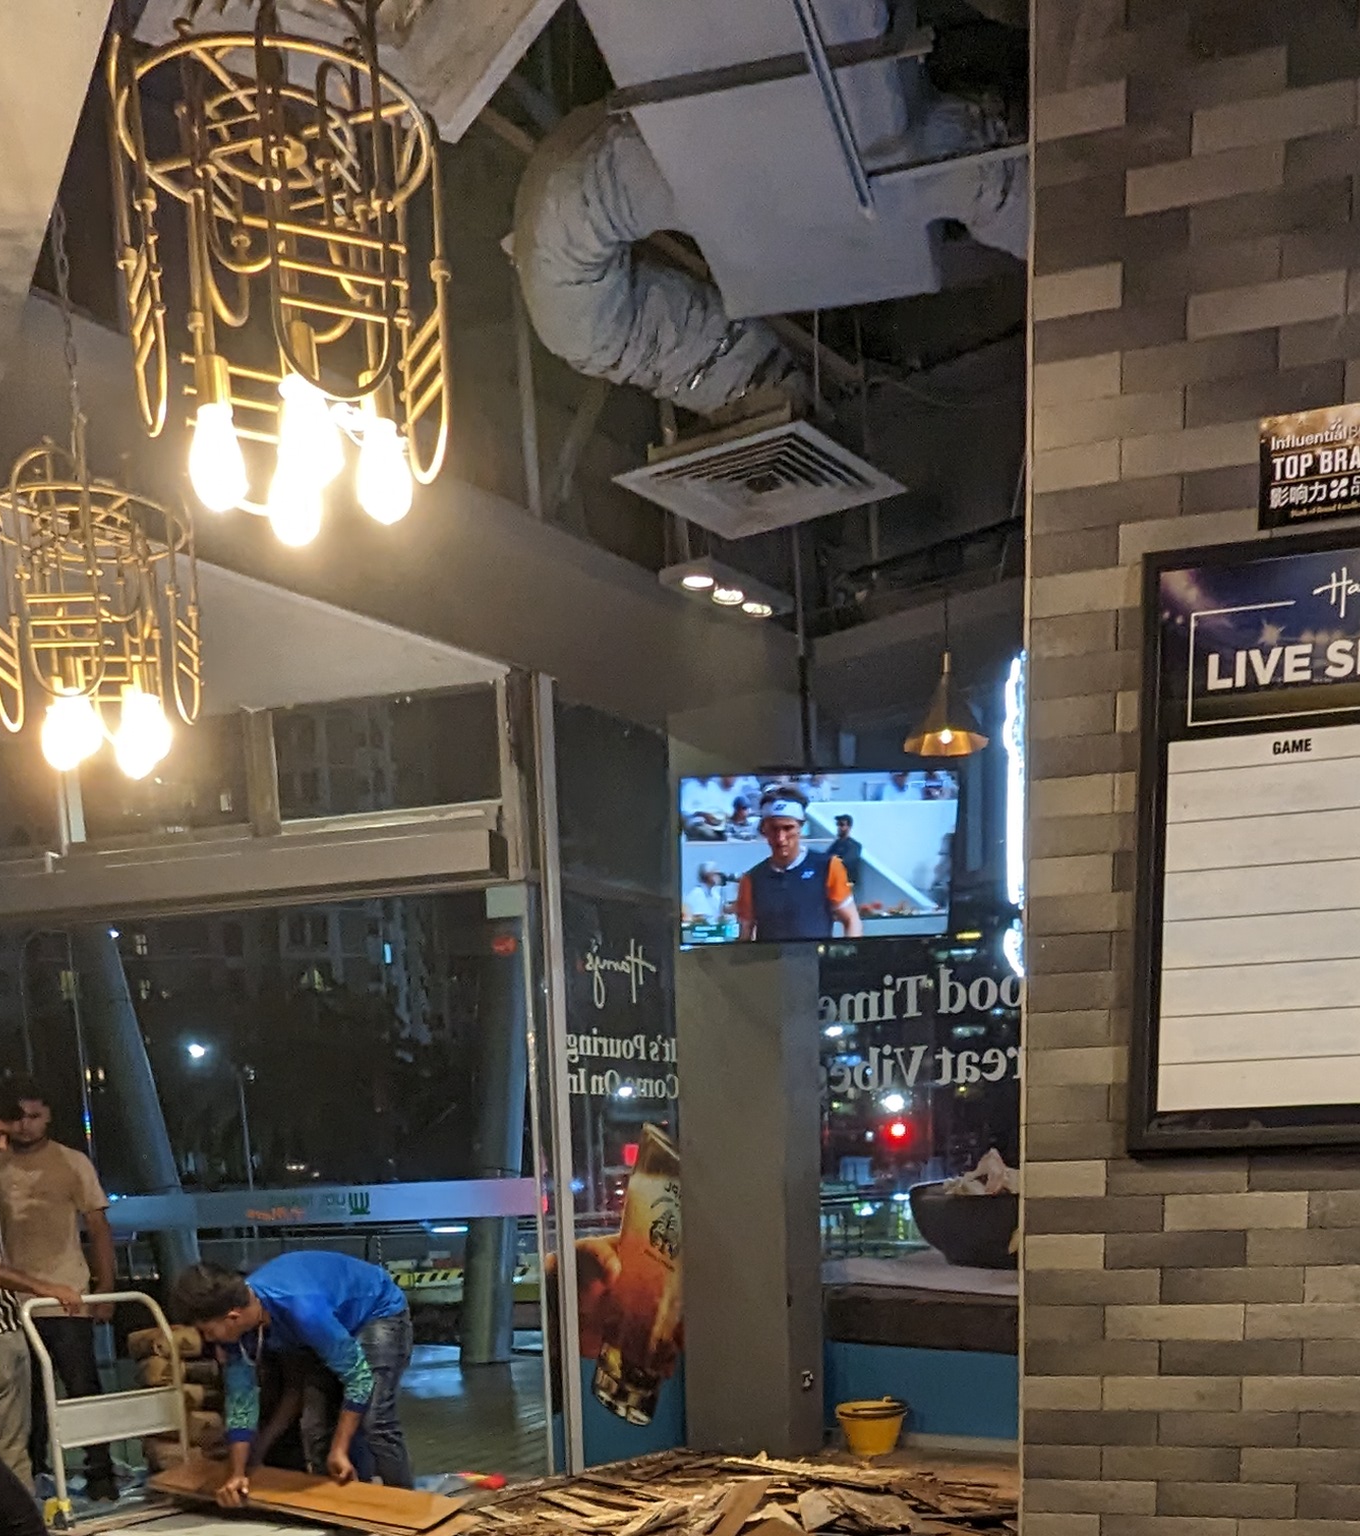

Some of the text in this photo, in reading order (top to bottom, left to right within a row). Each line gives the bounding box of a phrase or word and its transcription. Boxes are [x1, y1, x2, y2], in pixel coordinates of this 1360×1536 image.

[1271, 426, 1347, 450] Influential
[1272, 453, 1313, 481] TOP
[1270, 481, 1327, 509] 影响力
[1206, 643, 1313, 691] LIVE
[1272, 738, 1313, 755] GAME
